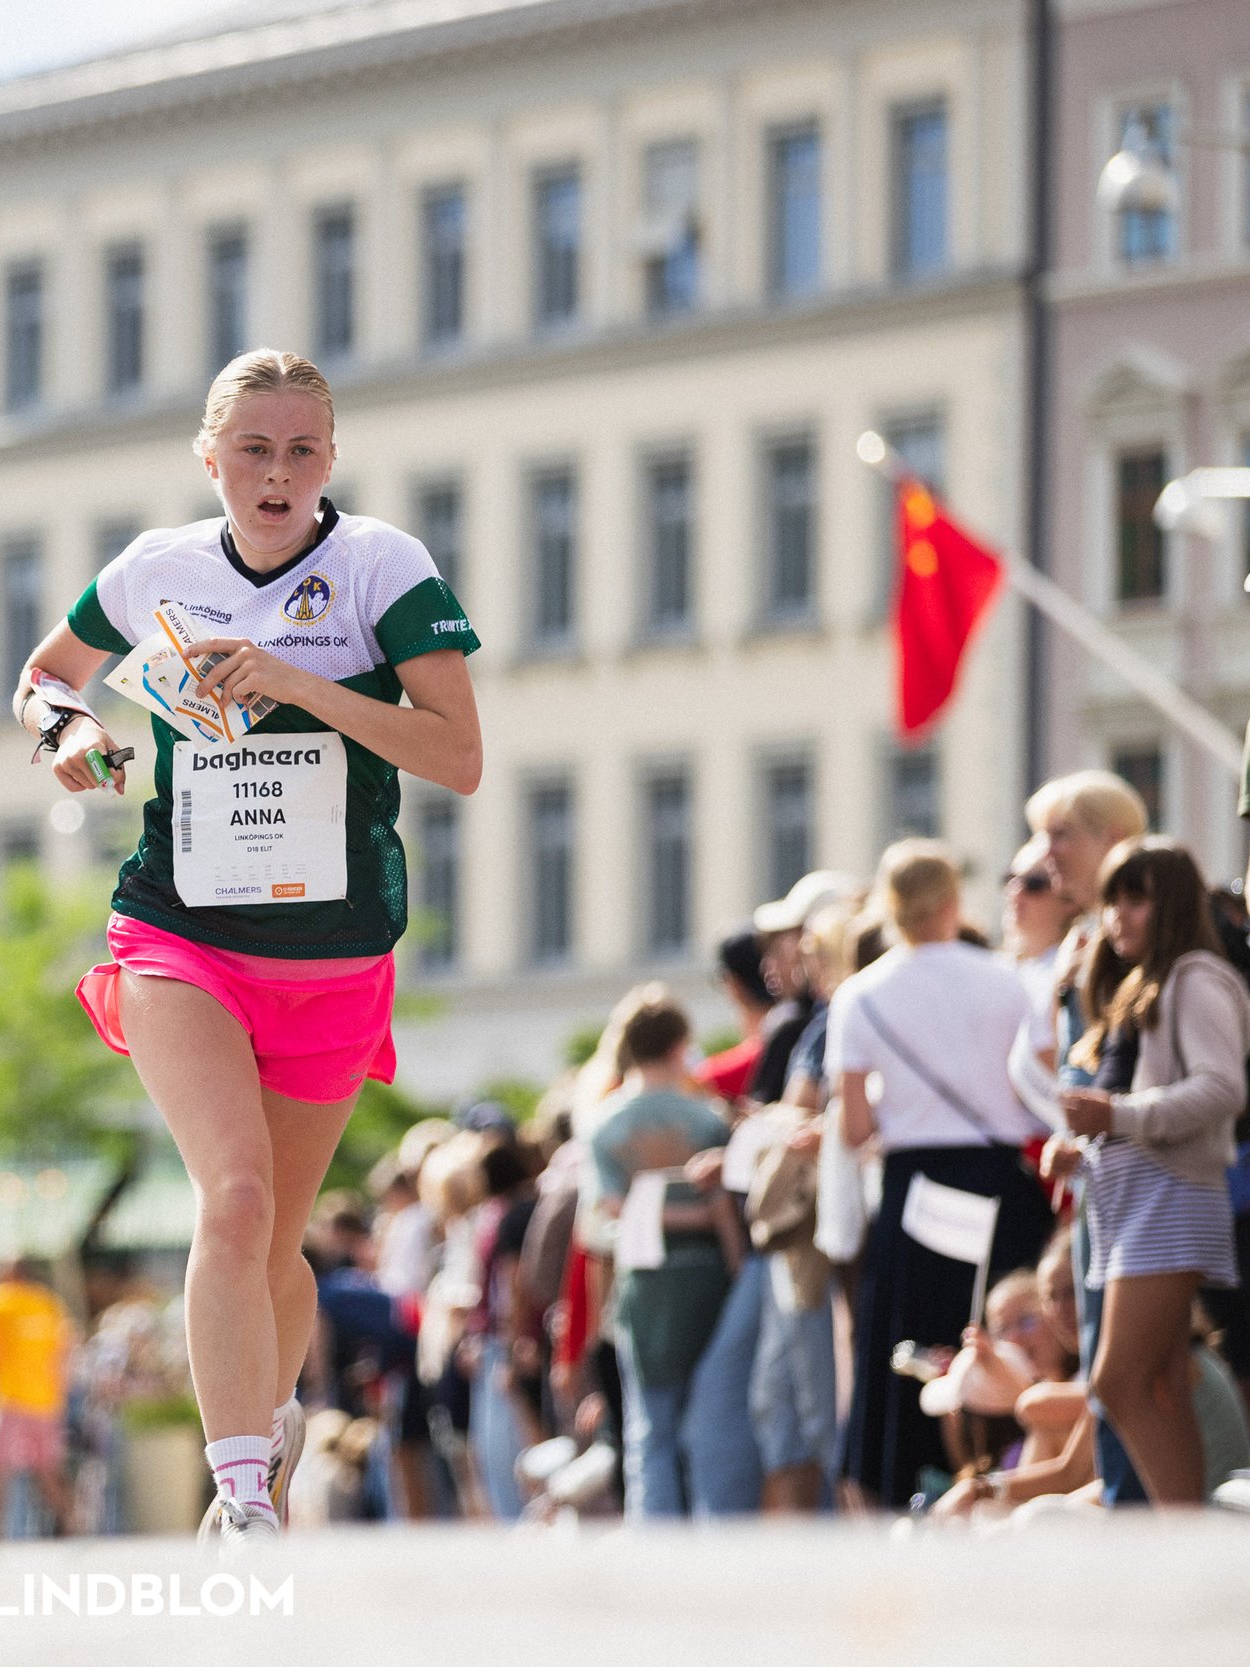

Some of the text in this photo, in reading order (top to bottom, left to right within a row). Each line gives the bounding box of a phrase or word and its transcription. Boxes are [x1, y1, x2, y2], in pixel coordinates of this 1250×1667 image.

[184, 604, 232, 622] Linköping
[257, 634, 349, 647] LINKÖPINGS OK
[193, 748, 321, 771] bagheera
[233, 781, 283, 799] 11168
[230, 808, 286, 826] ANNA
[215, 886, 262, 895] CHALMERS
